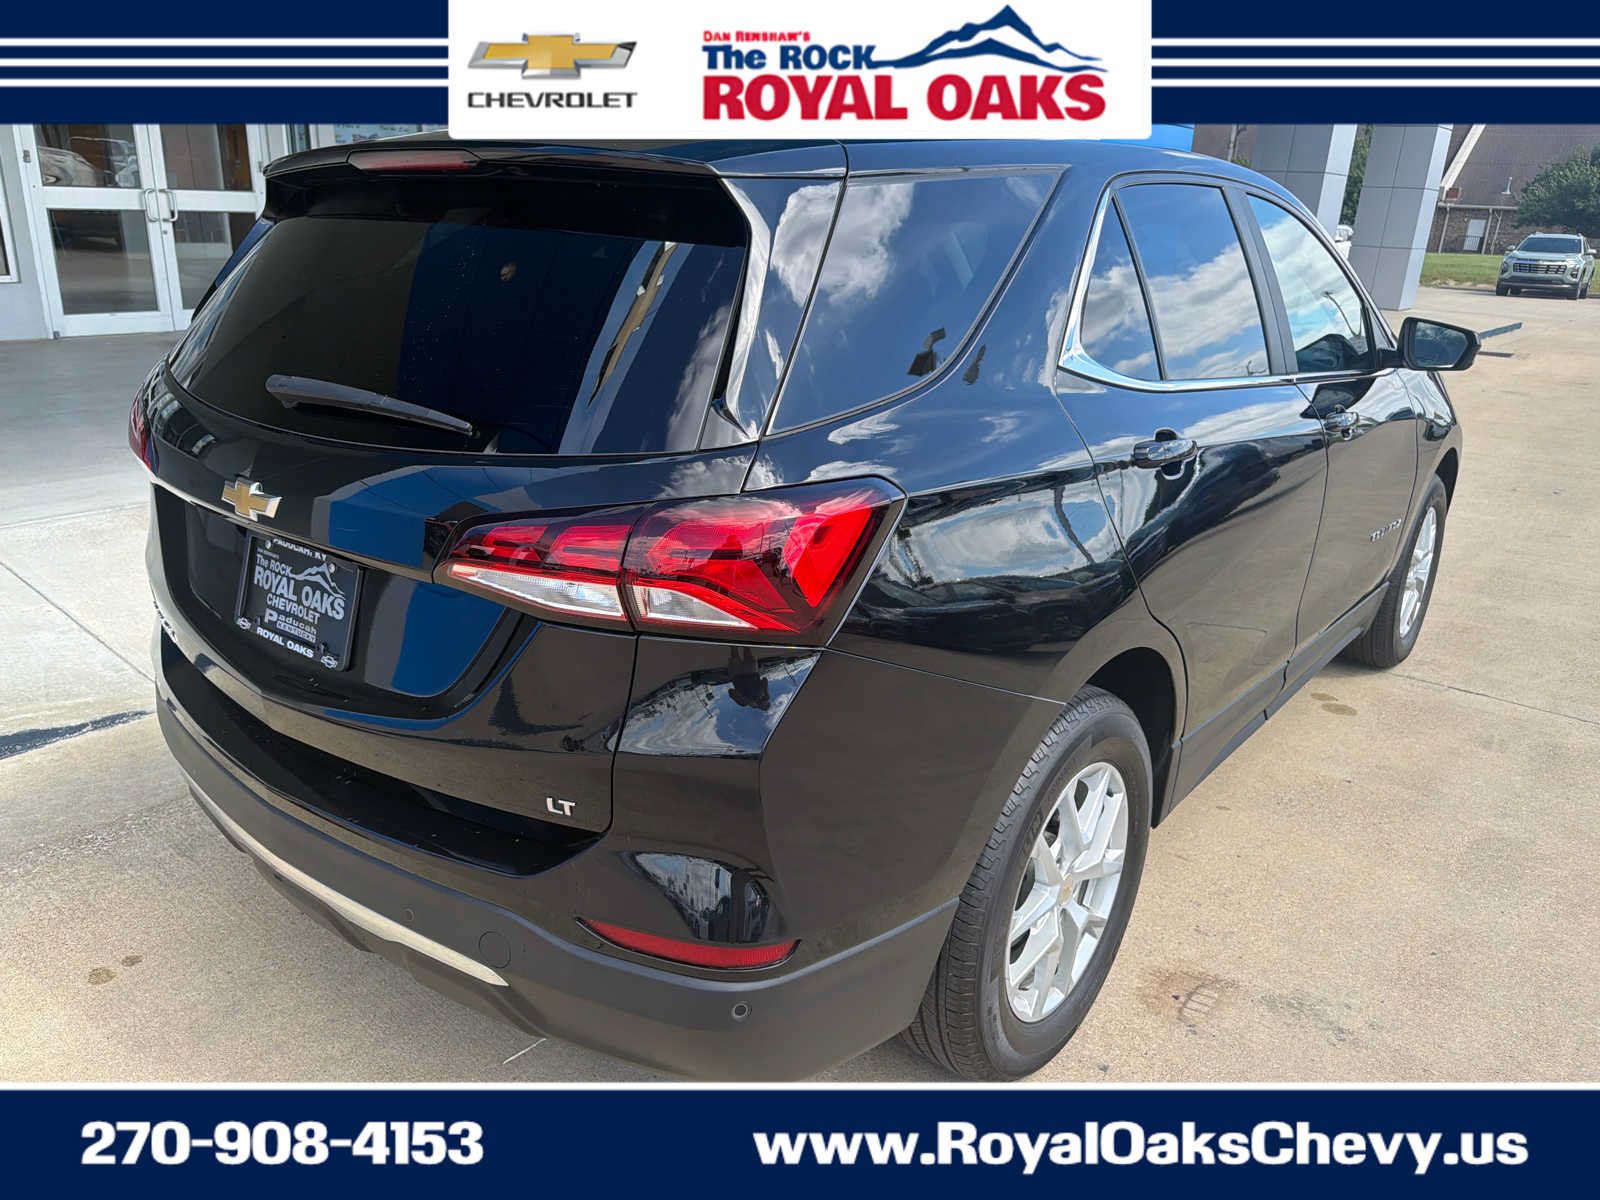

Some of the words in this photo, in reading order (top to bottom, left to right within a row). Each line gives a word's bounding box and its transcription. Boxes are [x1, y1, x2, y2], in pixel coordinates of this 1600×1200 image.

[256, 553, 269, 568] The
[269, 560, 293, 576] ROCK
[253, 565, 298, 602] ROYAL
[301, 585, 345, 620] OAKS
[264, 607, 317, 636] Paducah
[266, 592, 321, 625] CHEVROLET
[256, 626, 285, 646] ROYAL
[286, 640, 315, 658] OAKS
[546, 797, 576, 816] LT
